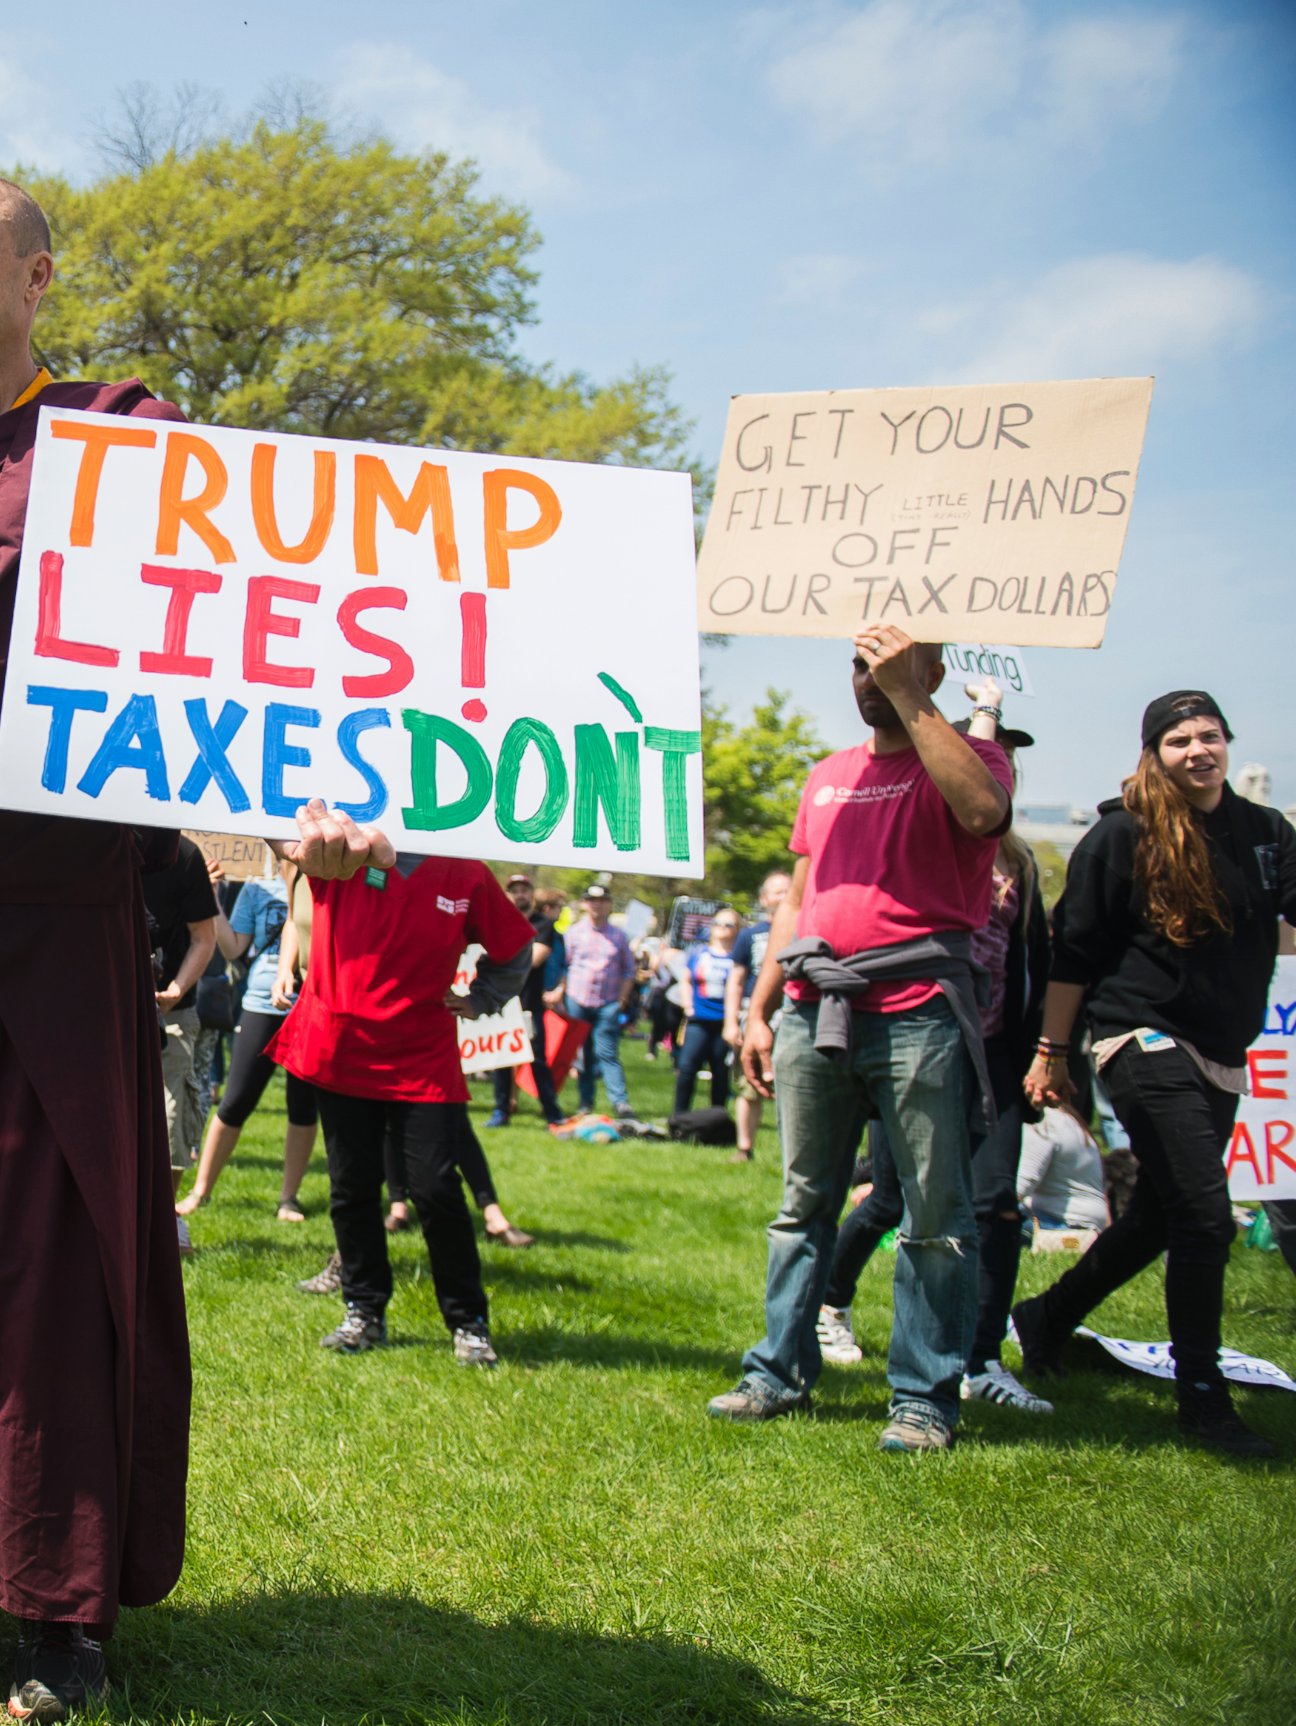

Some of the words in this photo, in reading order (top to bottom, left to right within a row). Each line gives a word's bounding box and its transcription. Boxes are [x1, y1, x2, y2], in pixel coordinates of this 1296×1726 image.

[735, 408, 855, 474] GET
[881, 403, 1034, 456] YOUR
[50, 419, 562, 589] TRUMP
[726, 483, 884, 532] FILTHY
[902, 492, 969, 512] LITTLE
[983, 470, 1130, 524] HANDS
[832, 526, 959, 568] OFF
[709, 573, 831, 617] OUR
[853, 573, 959, 620] TAX
[966, 570, 1118, 618] DOLLARS
[34, 549, 488, 723] LIES!
[26, 684, 392, 825] TAXES
[401, 671, 702, 863] DON'T
[203, 840, 266, 862] SILENT
[460, 1028, 525, 1059] ours
